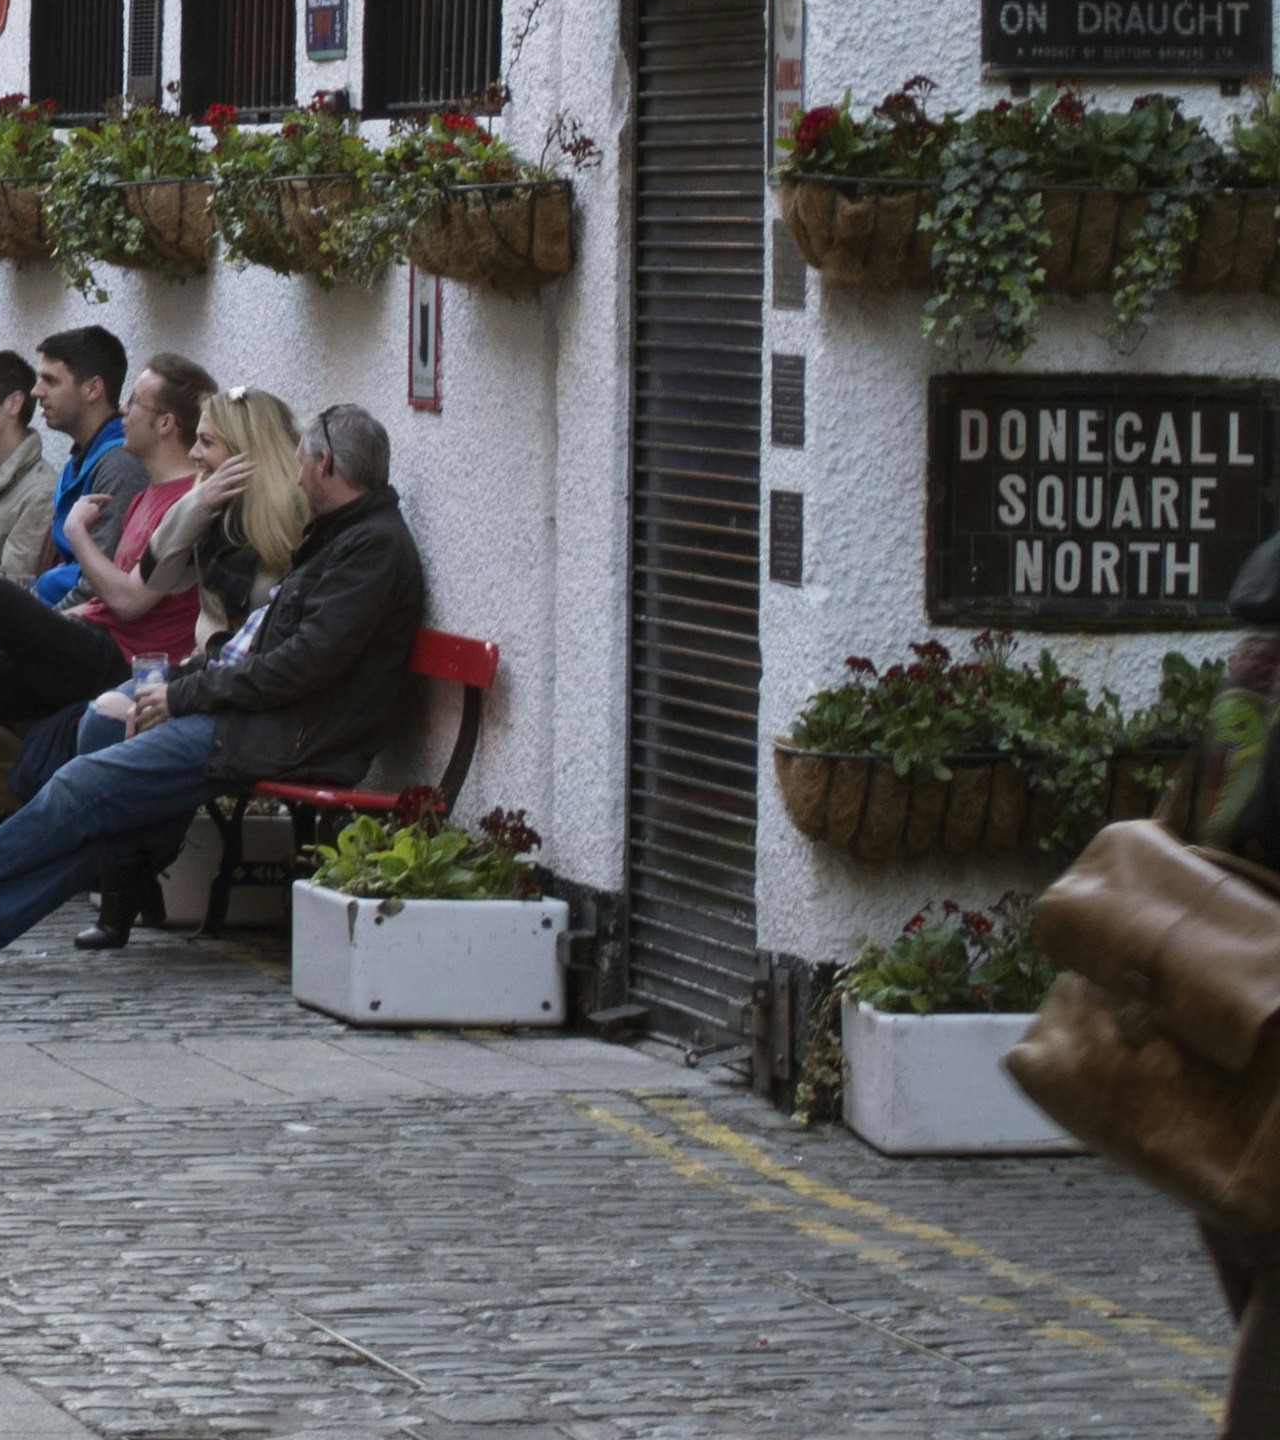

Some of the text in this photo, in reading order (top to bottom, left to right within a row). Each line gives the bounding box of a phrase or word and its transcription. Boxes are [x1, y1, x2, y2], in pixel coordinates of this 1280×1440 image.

[1000, 0, 1249, 35] ON DRAUGHT
[997, 473, 1218, 530] SQUARE
[1014, 539, 1200, 595] NORTH
